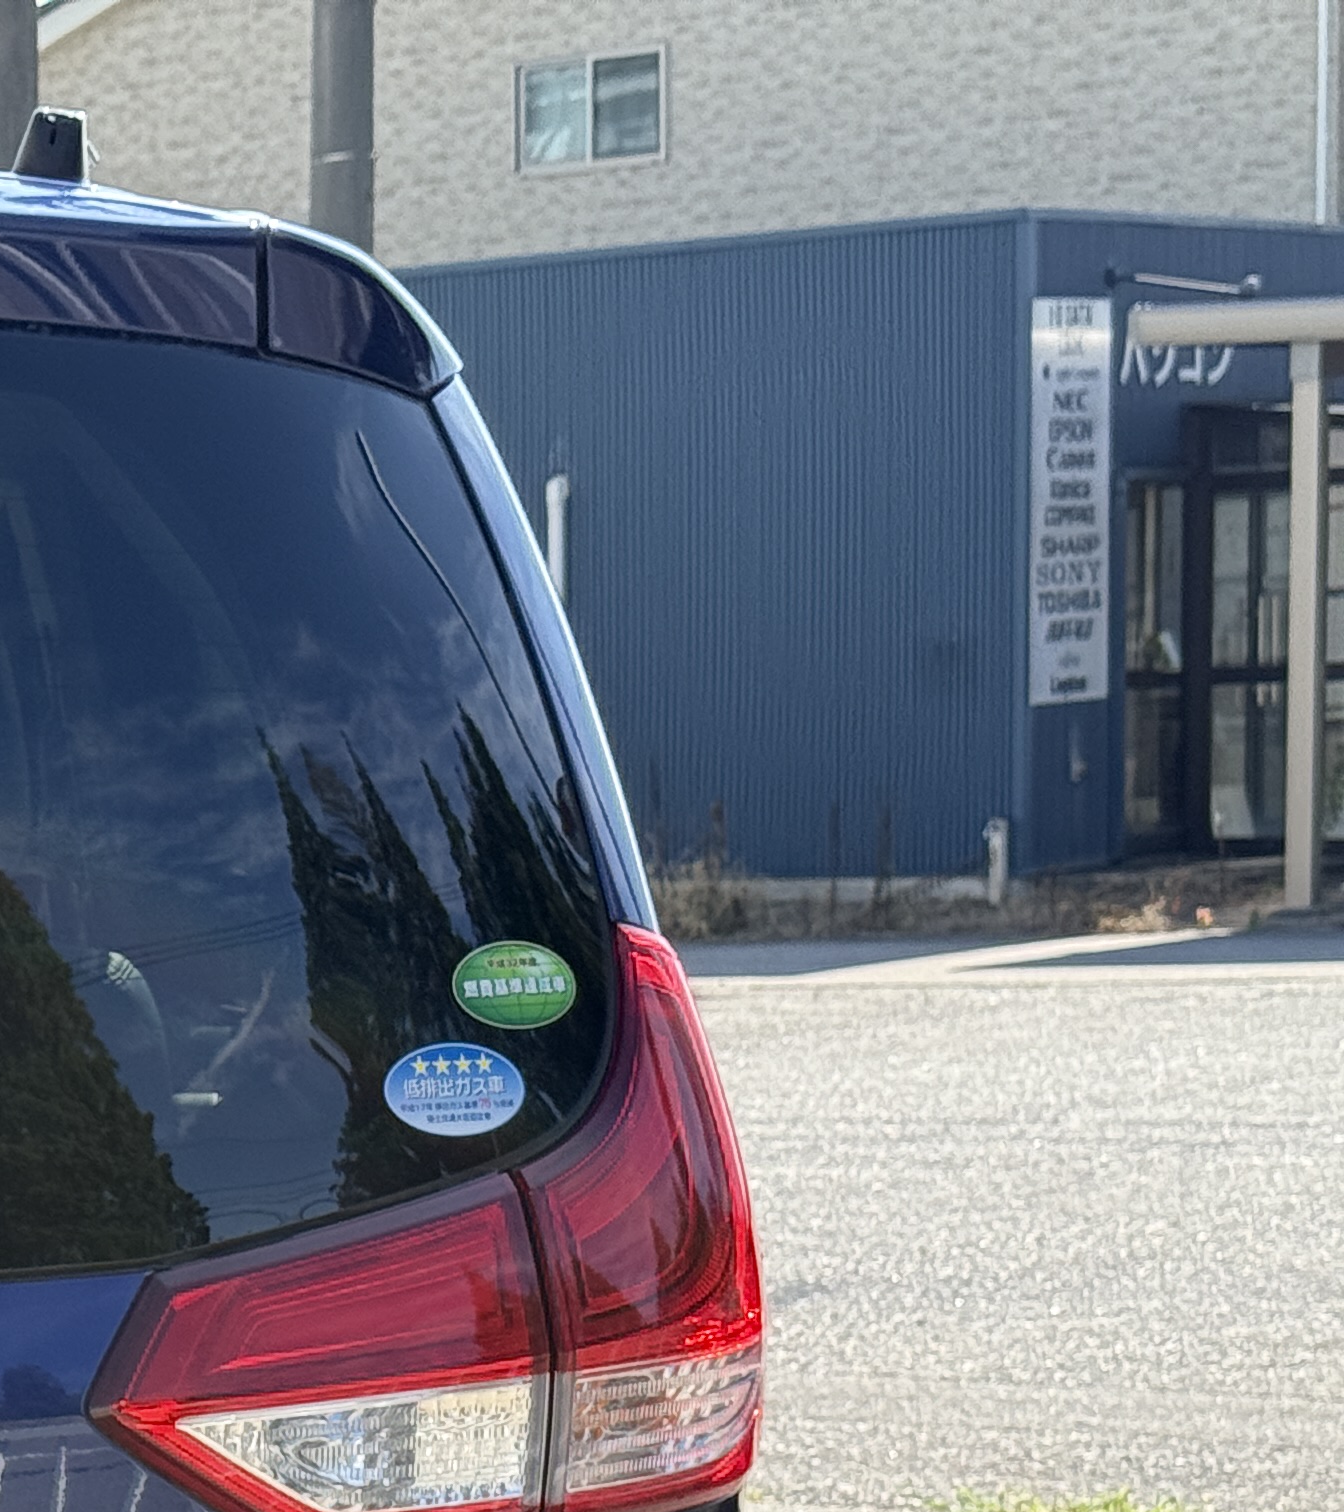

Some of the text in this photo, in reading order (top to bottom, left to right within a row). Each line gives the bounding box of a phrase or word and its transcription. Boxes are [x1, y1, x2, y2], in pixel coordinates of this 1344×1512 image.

[1053, 388, 1090, 413] NEC
[1048, 417, 1093, 443] EPSON
[1045, 446, 1095, 473] Canon
[1040, 533, 1101, 558] SHARP
[1036, 560, 1102, 586] SONY
[1038, 589, 1102, 614] TOSHIBA
[403, 1075, 507, 1099] 低排出ガス車
